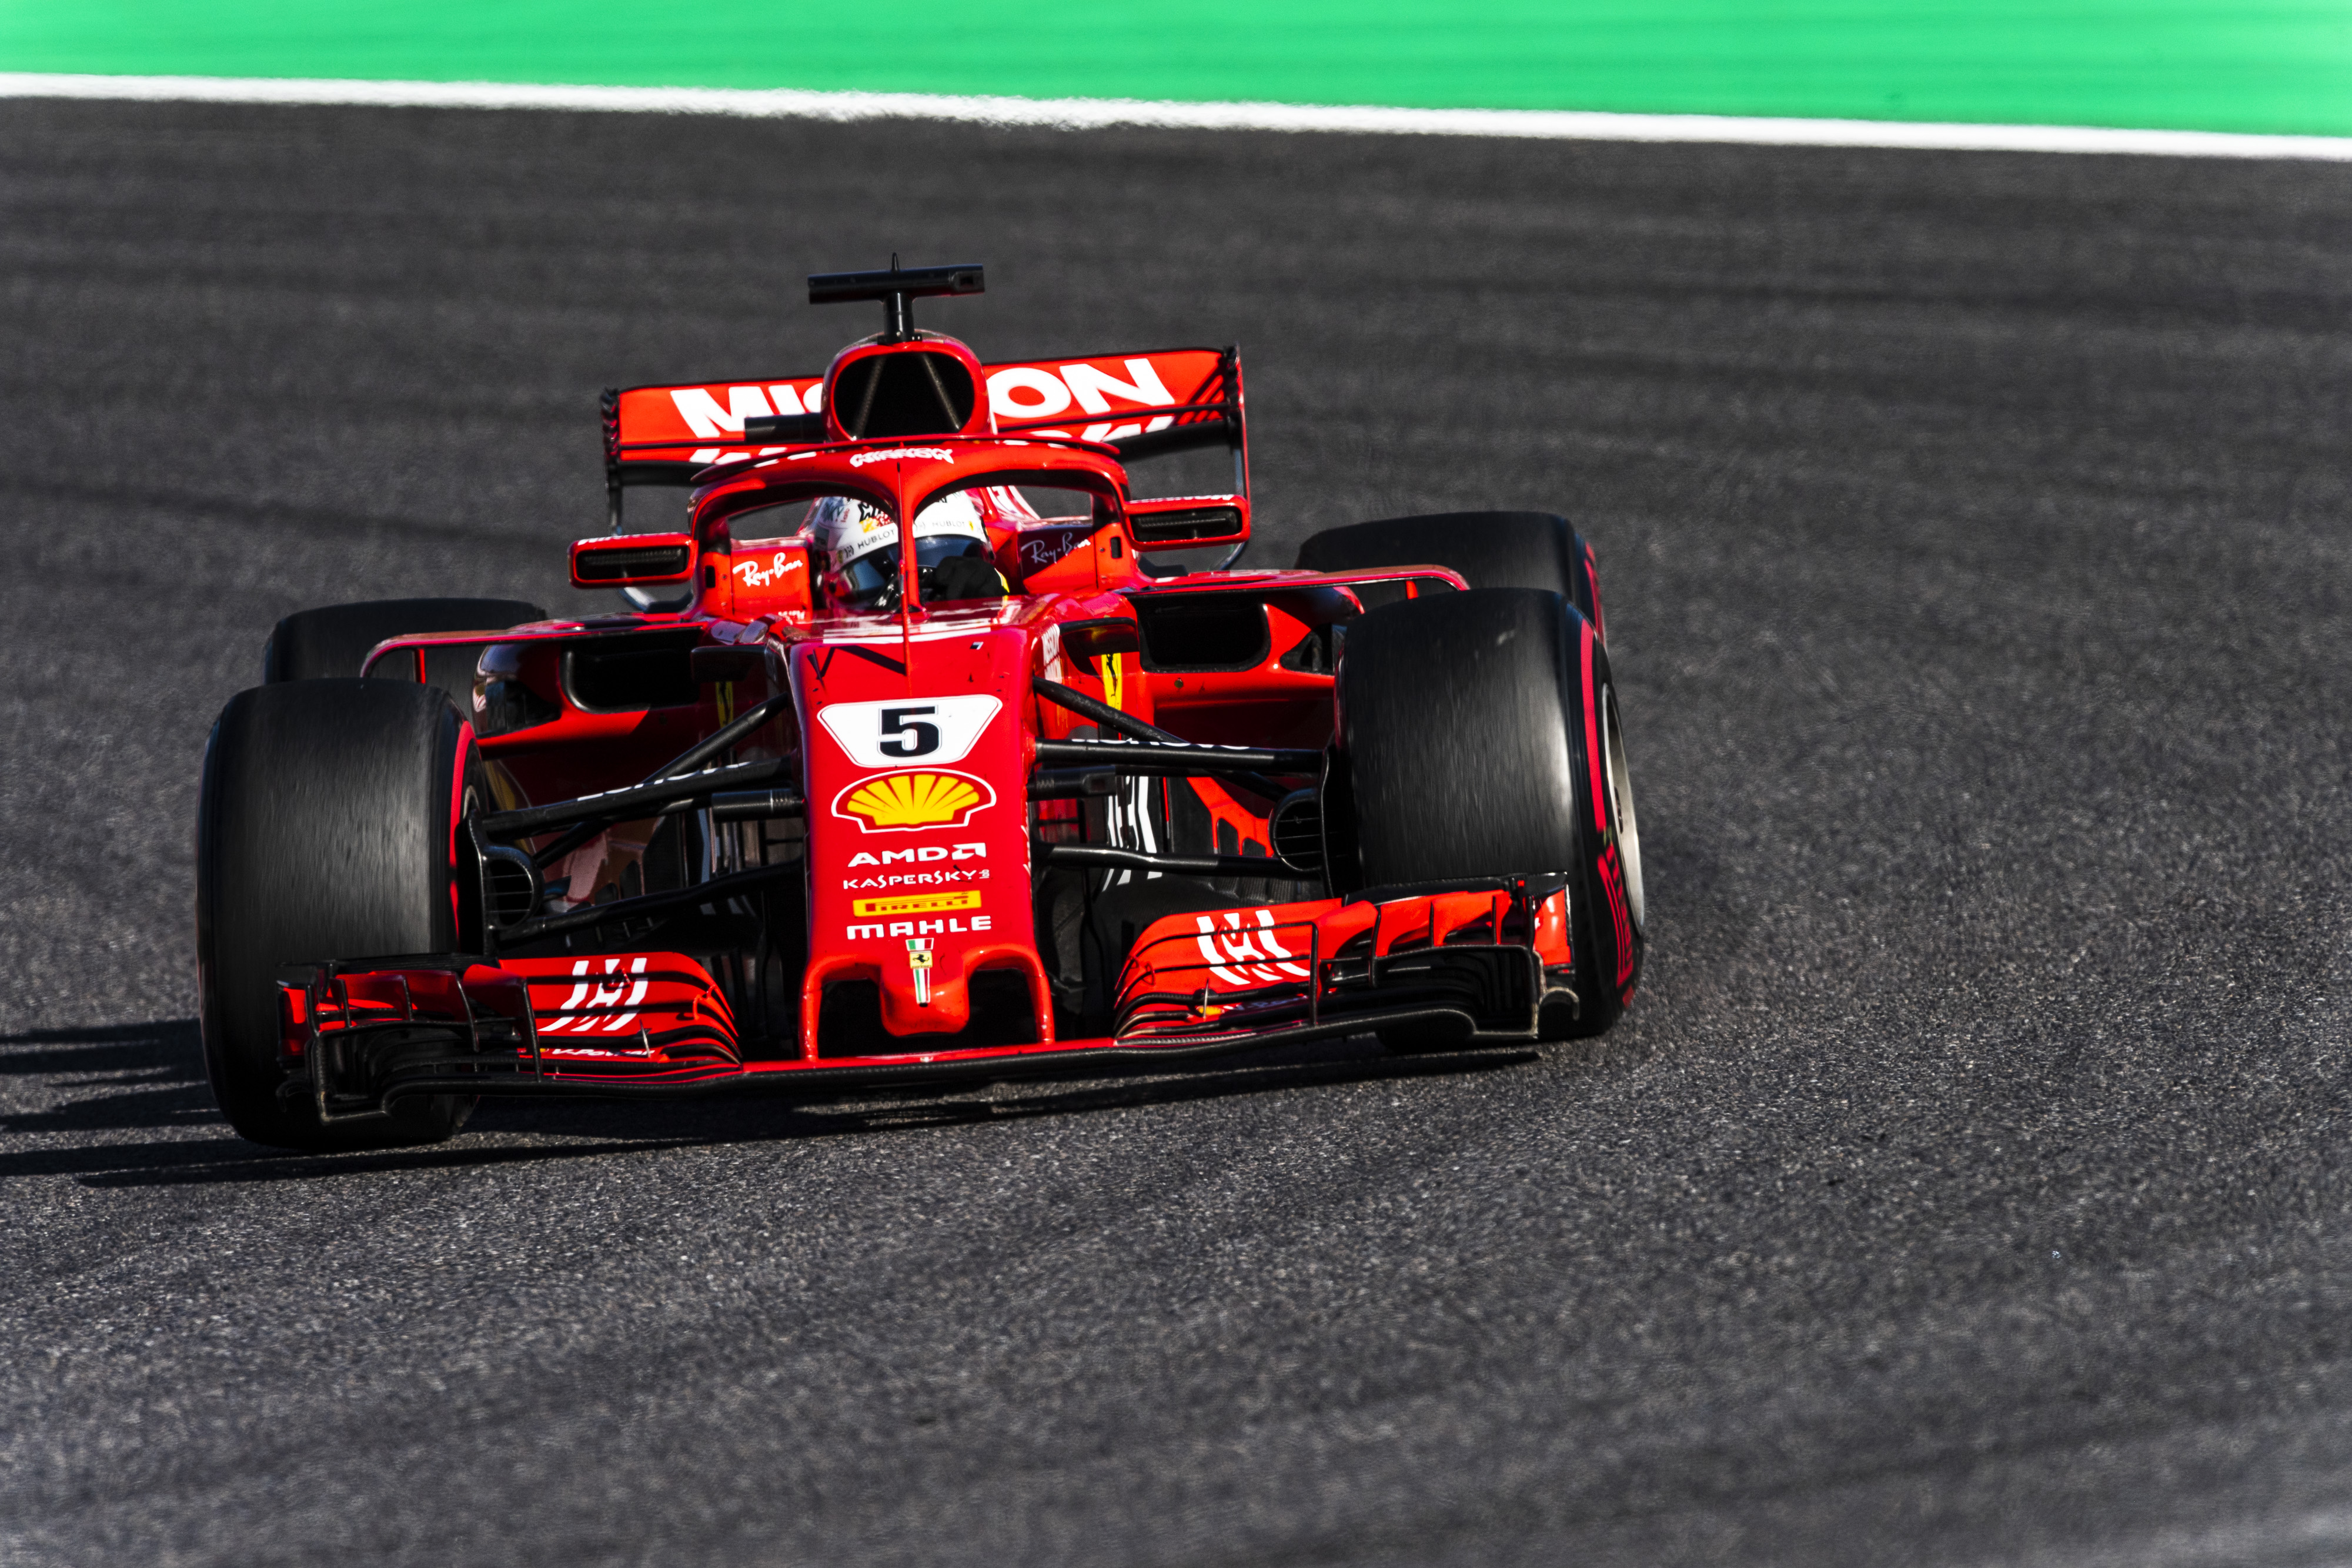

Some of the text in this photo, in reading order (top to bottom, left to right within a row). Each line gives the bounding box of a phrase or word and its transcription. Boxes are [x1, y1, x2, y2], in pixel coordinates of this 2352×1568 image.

[857, 530, 895, 550] HUBLOT
[878, 706, 942, 758] 5
[847, 847, 948, 868] AMD
[843, 870, 977, 890] KASPERSKY
[865, 895, 970, 912] PIRELLI
[847, 915, 992, 940] MAHLE
